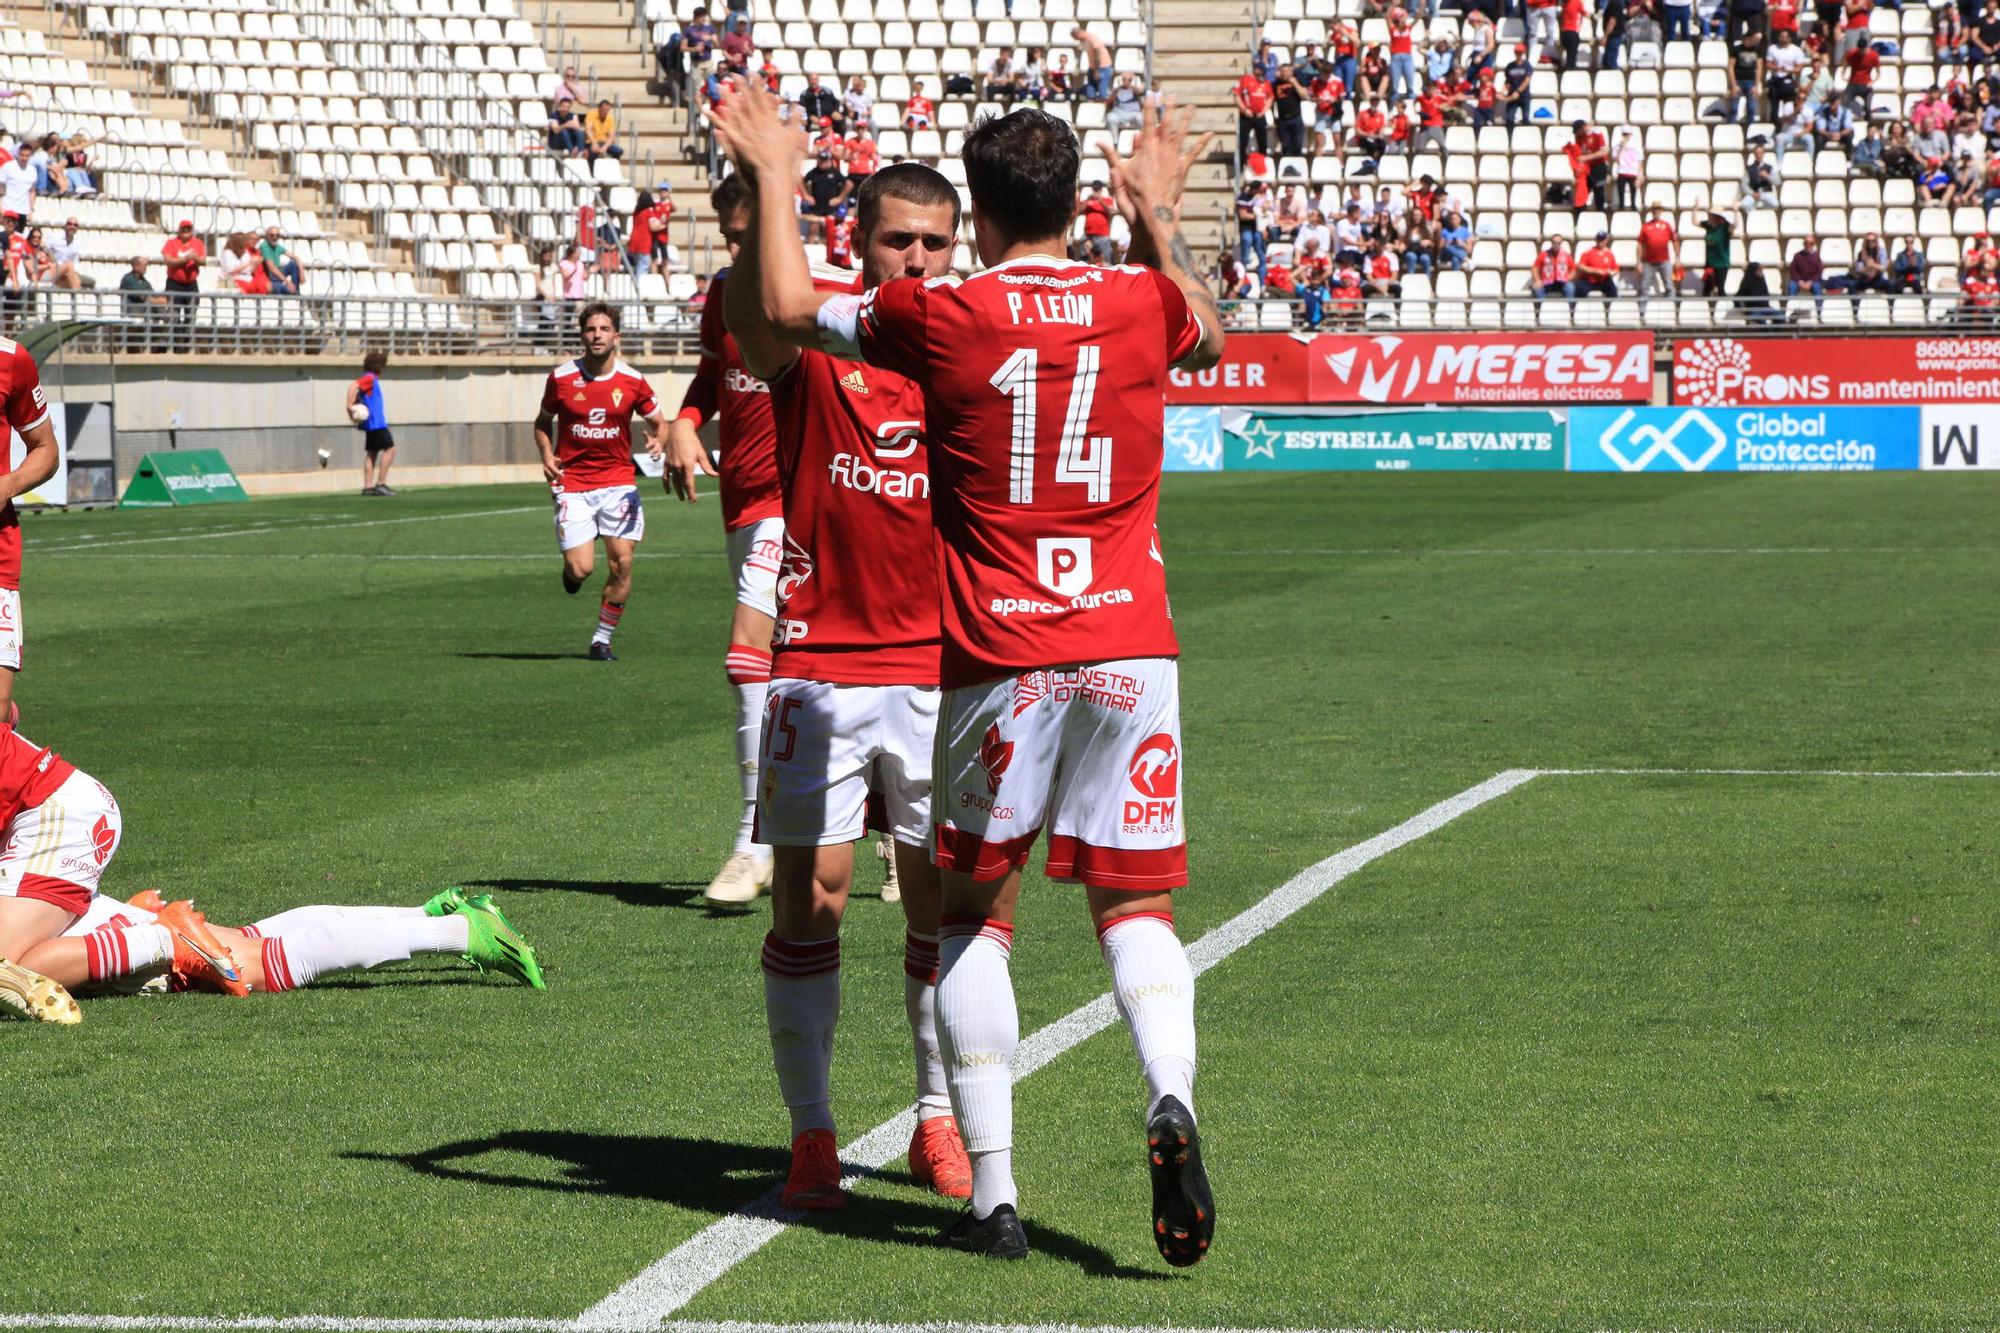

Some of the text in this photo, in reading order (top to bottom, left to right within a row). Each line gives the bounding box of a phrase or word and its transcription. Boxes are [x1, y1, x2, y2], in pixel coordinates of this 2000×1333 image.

[1006, 290, 1093, 327] P. LEÓN
[1426, 344, 1650, 384] MEFESA
[1916, 359, 2000, 374] www.prons.
[1454, 384, 1623, 401] Materiales eléctricos
[989, 346, 1112, 504] 14
[1736, 412, 1826, 437] Global
[1283, 431, 1414, 451] ESTRELLA
[1436, 431, 1552, 451] LEVANTE
[1735, 438, 1876, 463] Protección
[828, 453, 930, 499] fibran
[1051, 667, 1146, 696] CONSTRU
[1054, 686, 1138, 714] OTAMAR
[765, 693, 804, 762] 15
[1123, 801, 1176, 825] DFM
[1122, 825, 1149, 835] RENT
[1152, 825, 1159, 834] A
